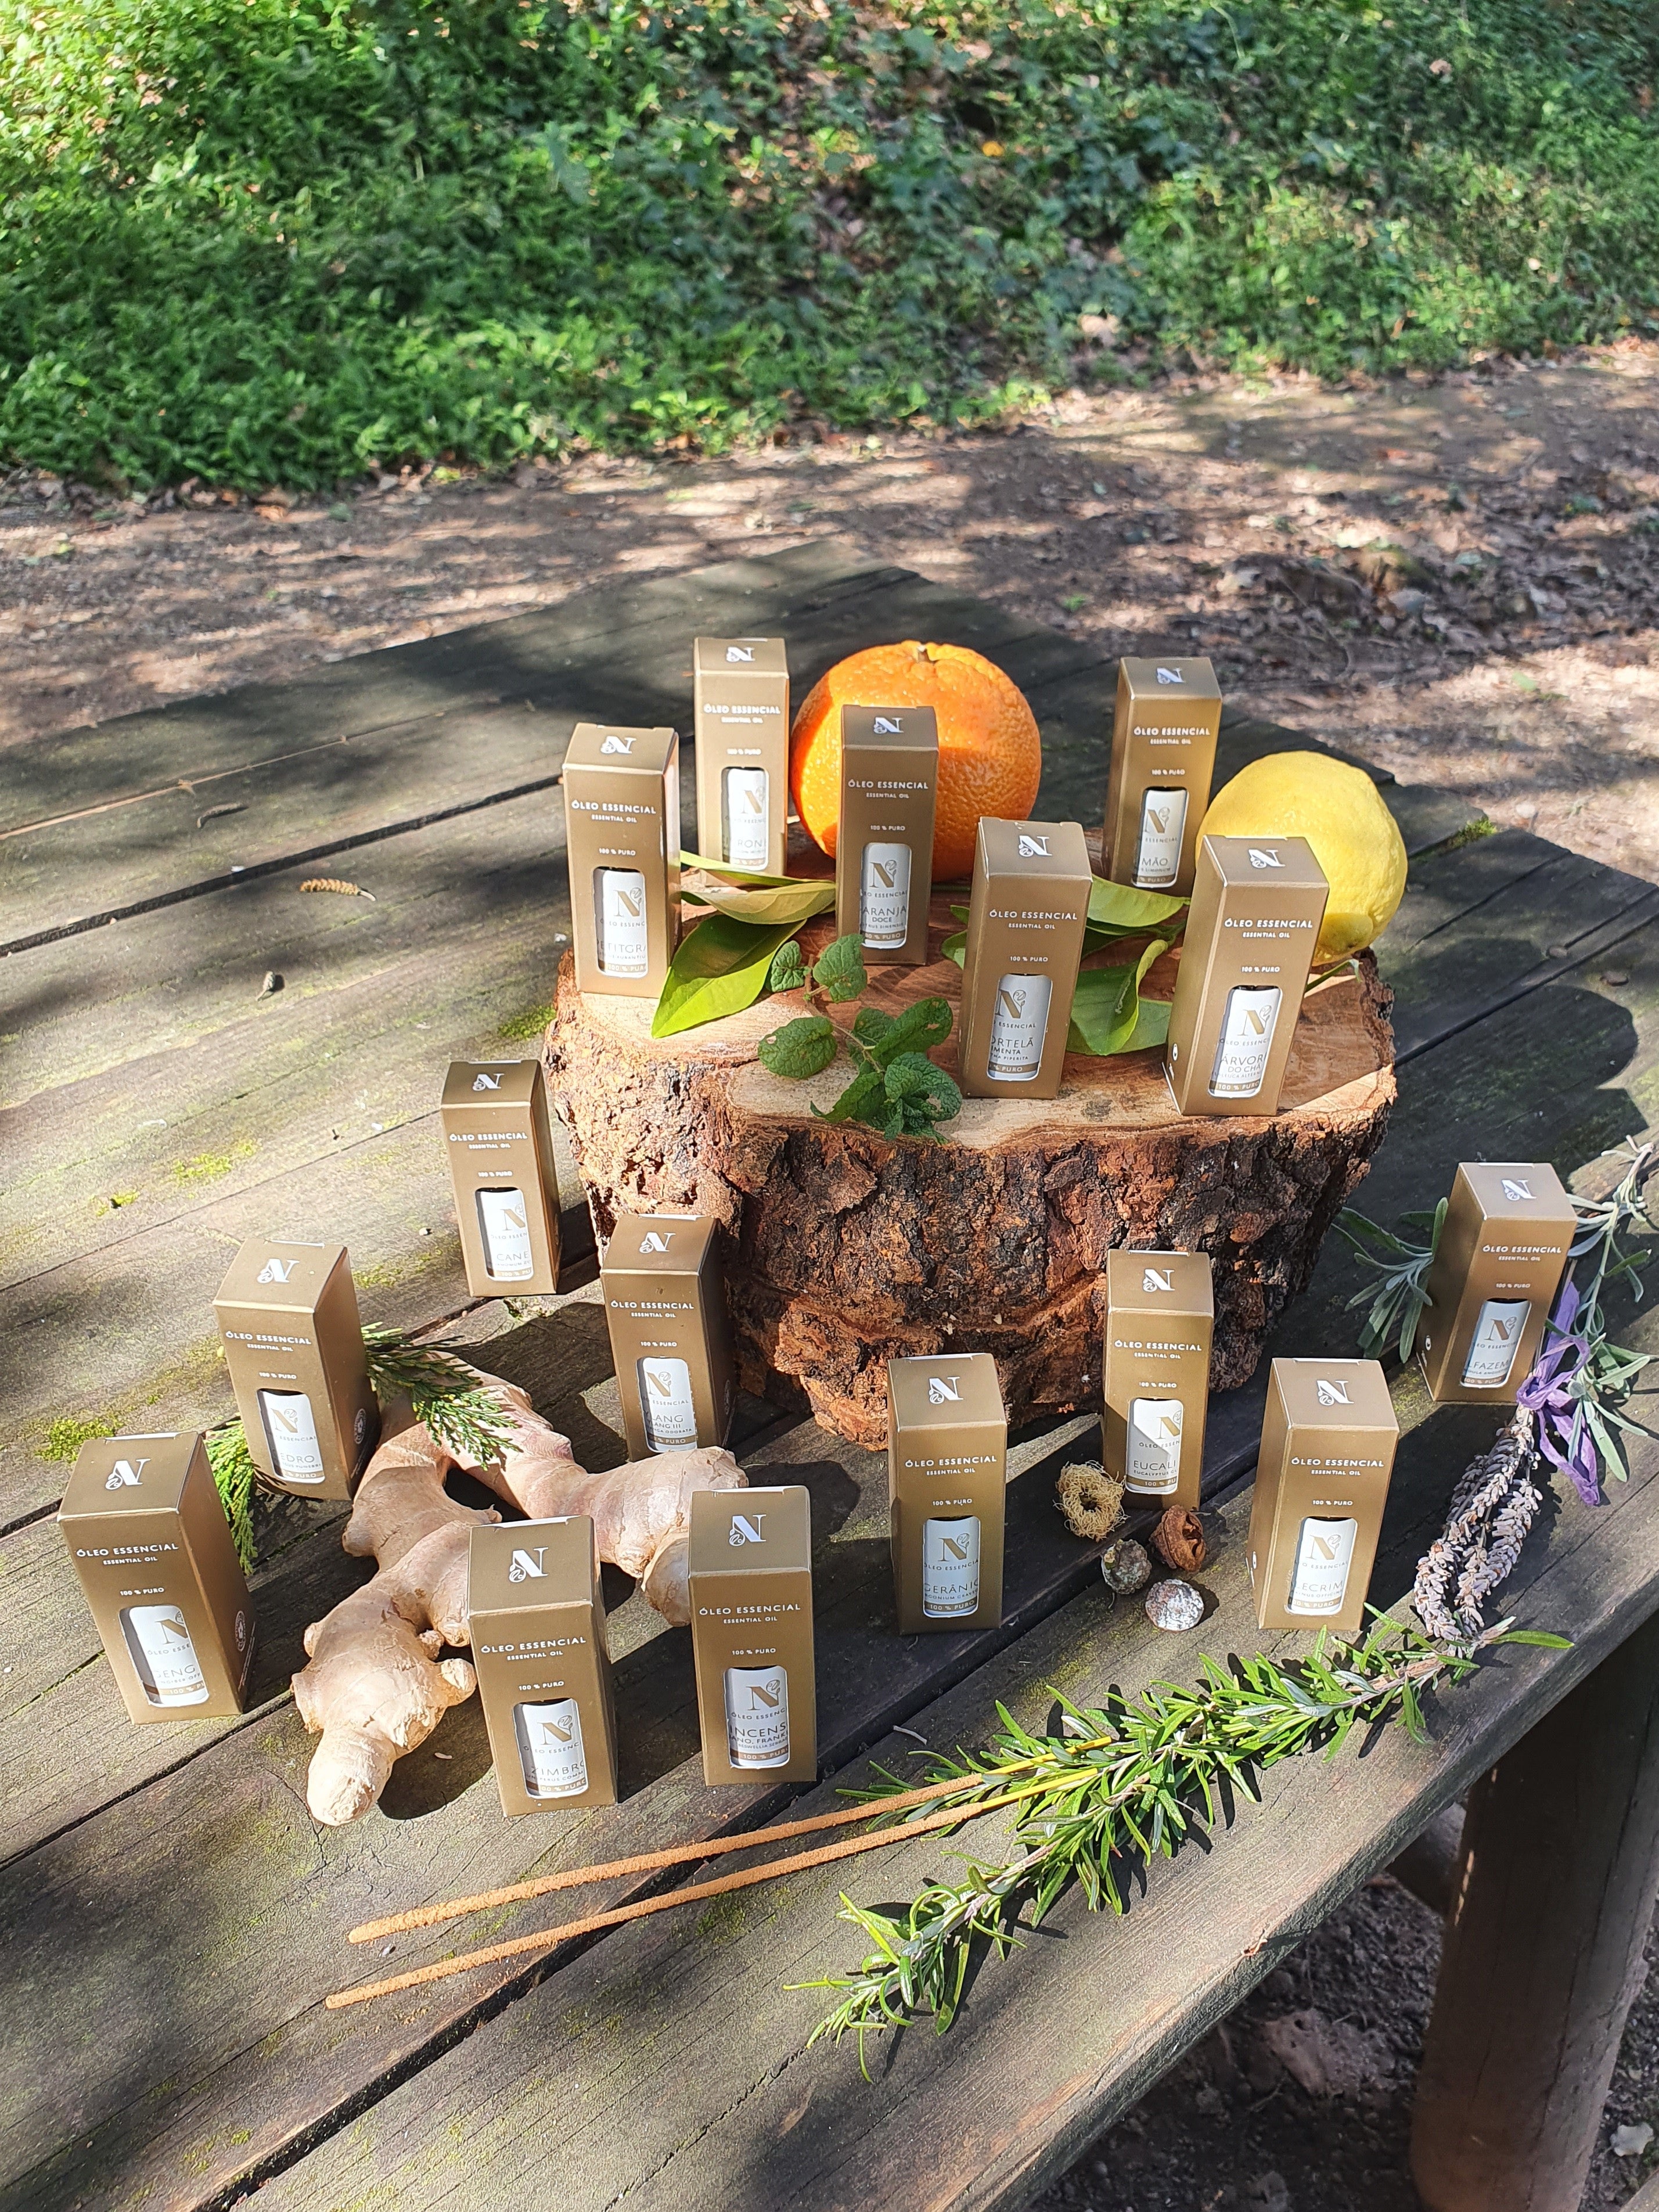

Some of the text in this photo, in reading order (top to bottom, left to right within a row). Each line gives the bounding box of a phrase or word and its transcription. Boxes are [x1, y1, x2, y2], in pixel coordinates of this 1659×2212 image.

[848, 779, 873, 787] ÓLEO
[571, 799, 656, 814] ÓLEO ESSENCIAL
[989, 909, 1078, 920] ÓLEO ESSENCIAL
[1225, 918, 1313, 928] ÓLEO ESSENCIAL
[477, 1132, 527, 1141] ESSENCIAL
[611, 1300, 637, 1308] ÓLEO
[225, 1331, 311, 1344] ÓLEO ESSENCIAL
[1115, 1340, 1201, 1351] ÓLEO ESSENCIAL
[905, 1455, 997, 1468] ÓLEO ESSENCIAL
[1291, 1457, 1320, 1465] ÓLEO
[76, 1543, 179, 1557] ÓLEO ESSENCIAL
[699, 1603, 801, 1616] ÓLEO ESSENCIAL
[955, 1600, 974, 1610] PURO
[481, 1636, 586, 1653] ÓLEO ESSENCIAL
[507, 1653, 546, 1661] ESSENTIAL
[731, 1711, 752, 1720] ÓLEO
[730, 1721, 788, 1738] INCENS
